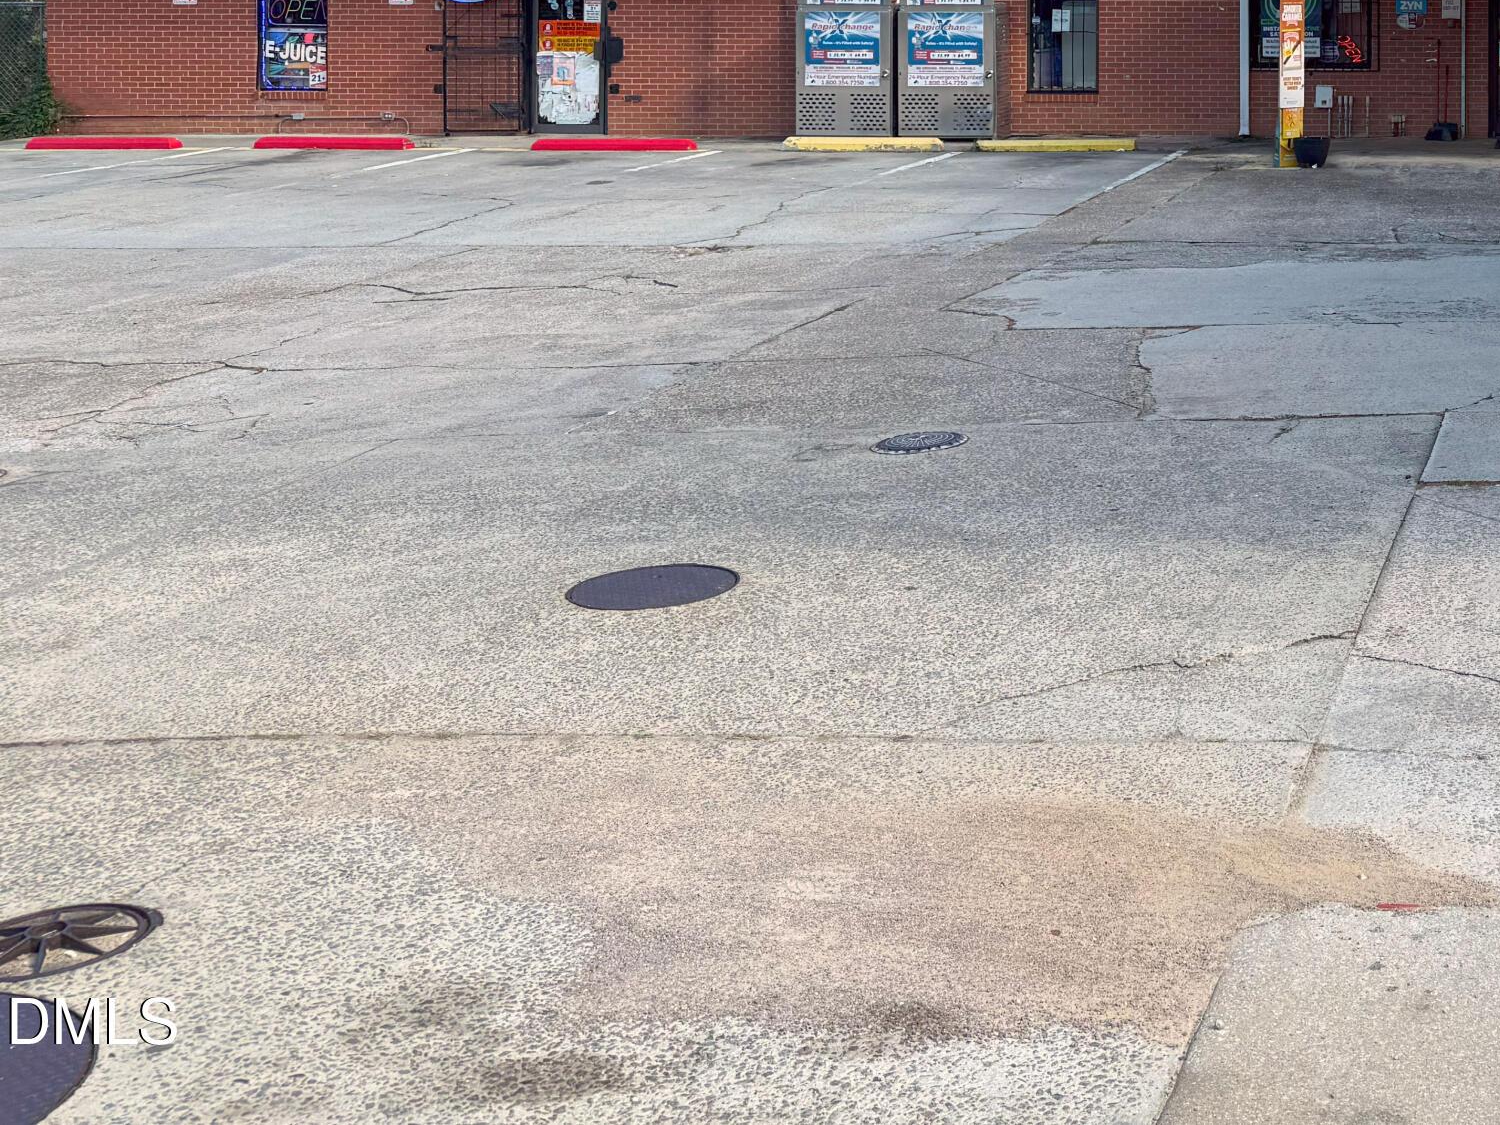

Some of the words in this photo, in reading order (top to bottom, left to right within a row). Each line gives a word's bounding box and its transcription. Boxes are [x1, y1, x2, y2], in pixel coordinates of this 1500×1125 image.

[1400, 1, 1423, 10] ZYN
[265, 40, 326, 65] E-JUICE
[1337, 35, 1366, 64] OPEN
